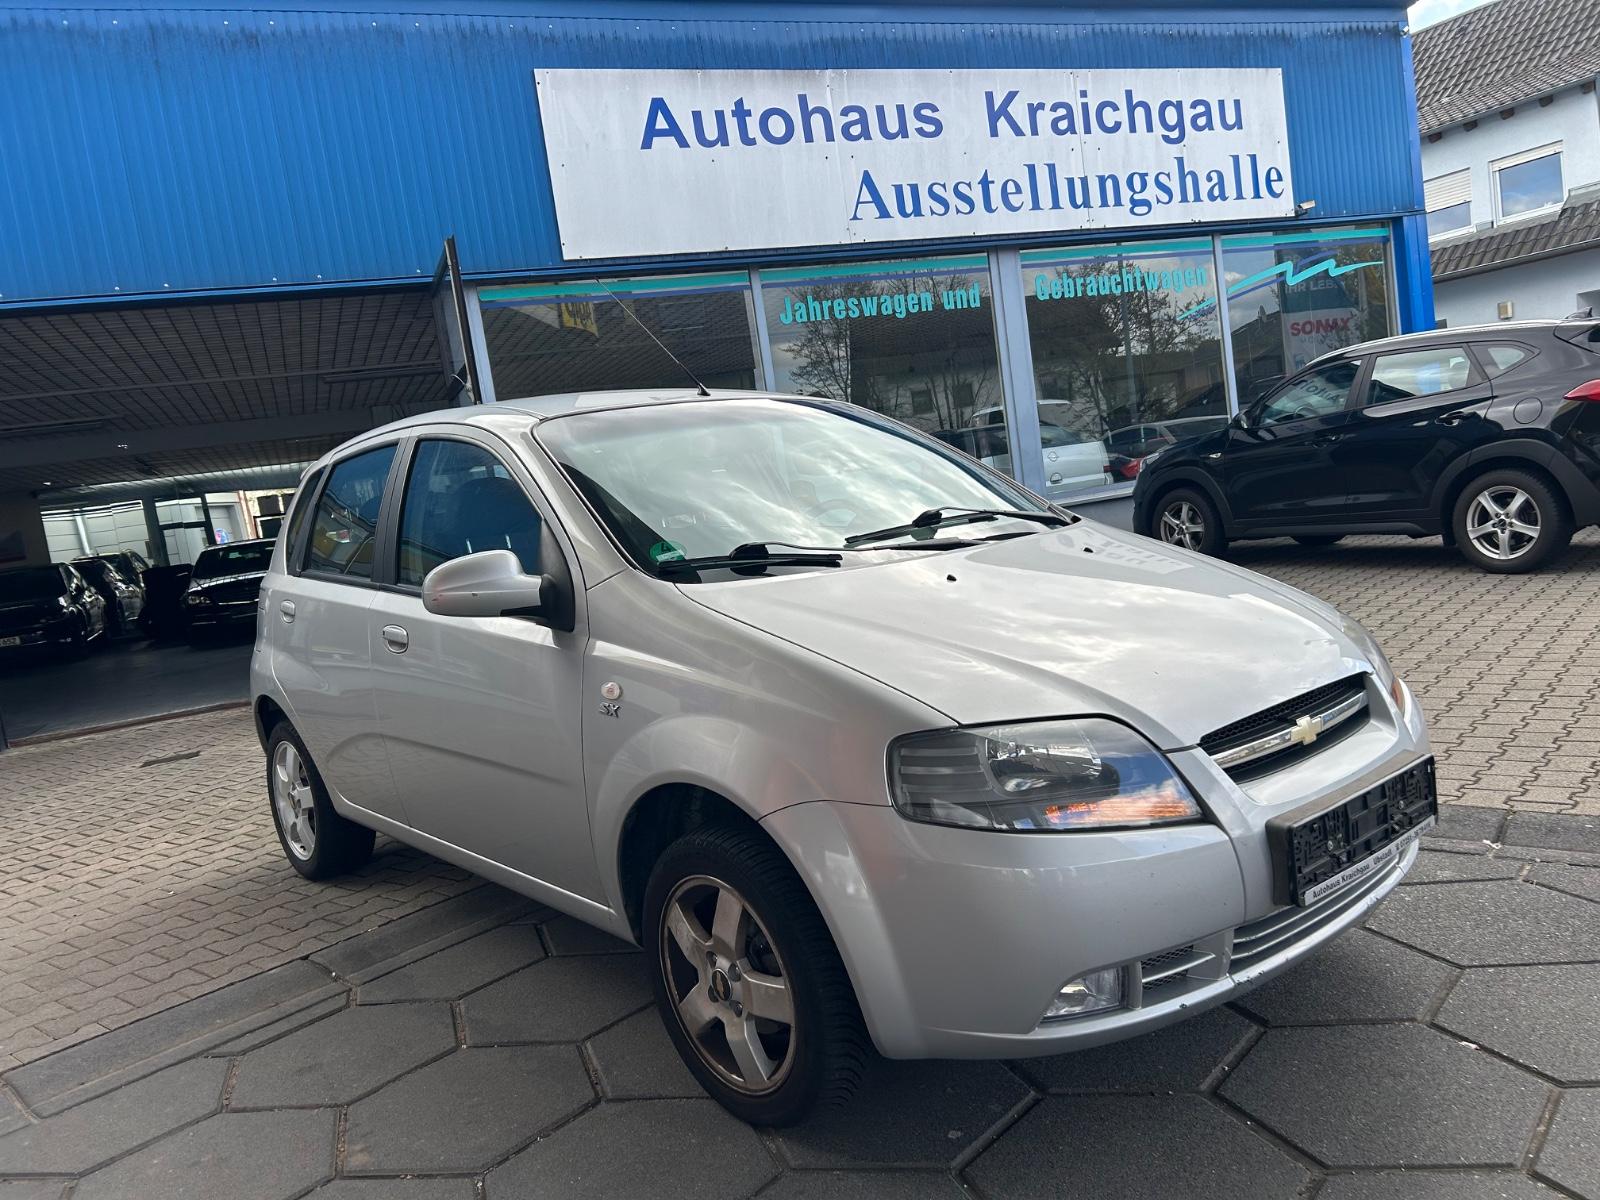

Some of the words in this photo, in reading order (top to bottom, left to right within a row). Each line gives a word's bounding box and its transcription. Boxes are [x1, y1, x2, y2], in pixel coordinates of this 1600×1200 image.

[641, 95, 943, 150] Autohaus
[985, 90, 1242, 144] Kraichgau
[850, 154, 1285, 221] Ausstellungshalle
[1035, 263, 1208, 301] Gebrauchtwagen
[779, 291, 933, 325] Jahreswagen
[942, 281, 980, 310] und
[599, 702, 621, 718] SX
[1312, 880, 1341, 899] Autohaus
[1340, 864, 1370, 884] Kraichgau
